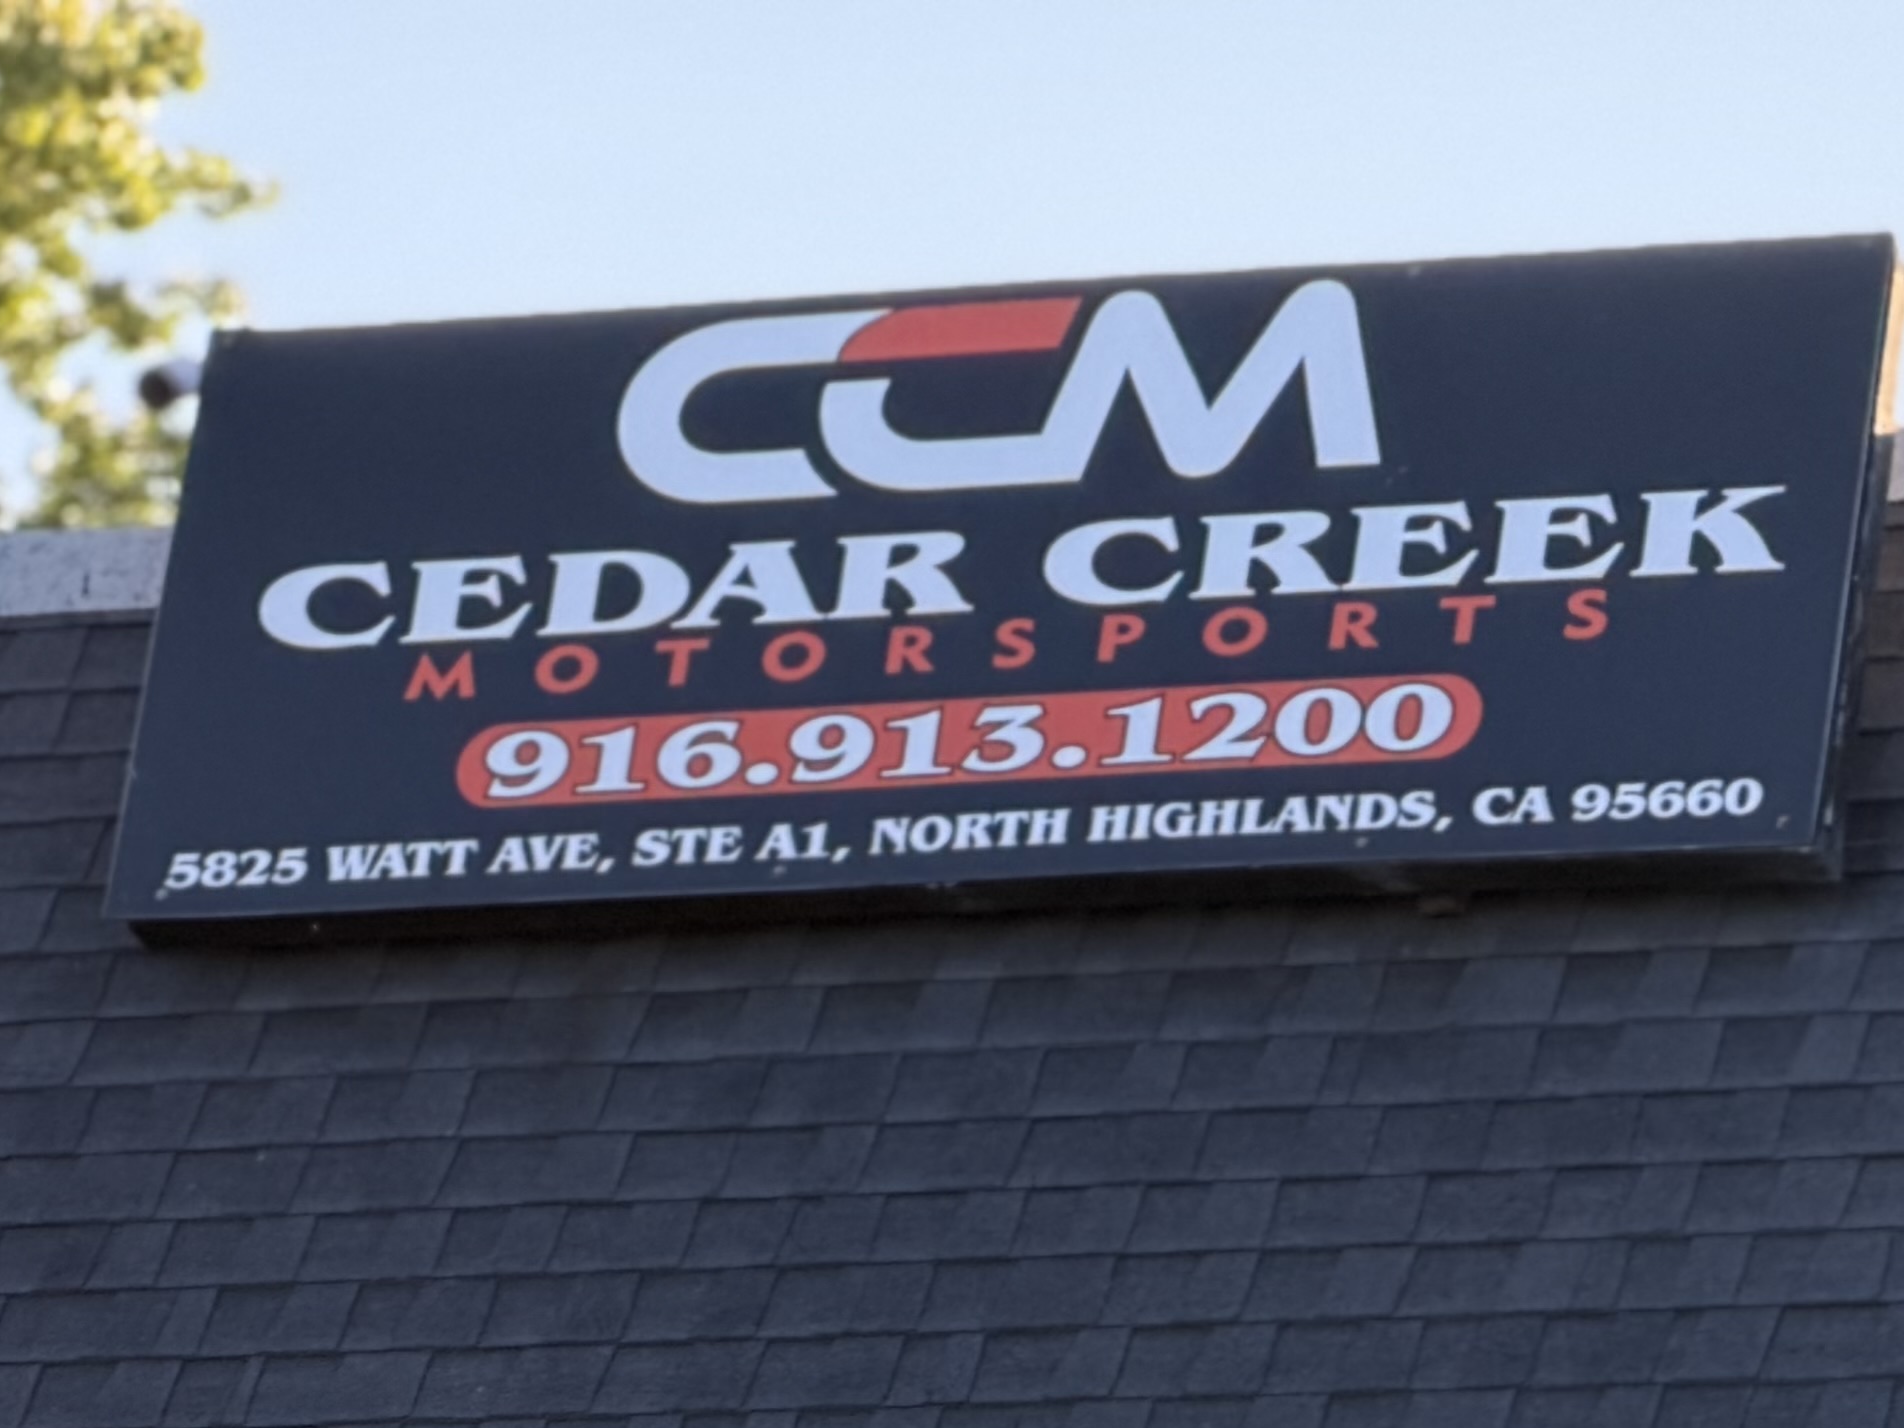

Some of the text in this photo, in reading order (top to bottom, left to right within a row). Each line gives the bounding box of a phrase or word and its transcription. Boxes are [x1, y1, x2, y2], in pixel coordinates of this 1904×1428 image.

[618, 279, 1380, 503] CCM
[258, 486, 1786, 648] CEDAR CREEK
[403, 588, 1610, 699] MOTORSPORTS
[484, 683, 1454, 799] 916.913.1200
[164, 777, 1765, 889] 5825 WATT AVE, STE A1, NORTH HIGHLANDS, CA 95660
